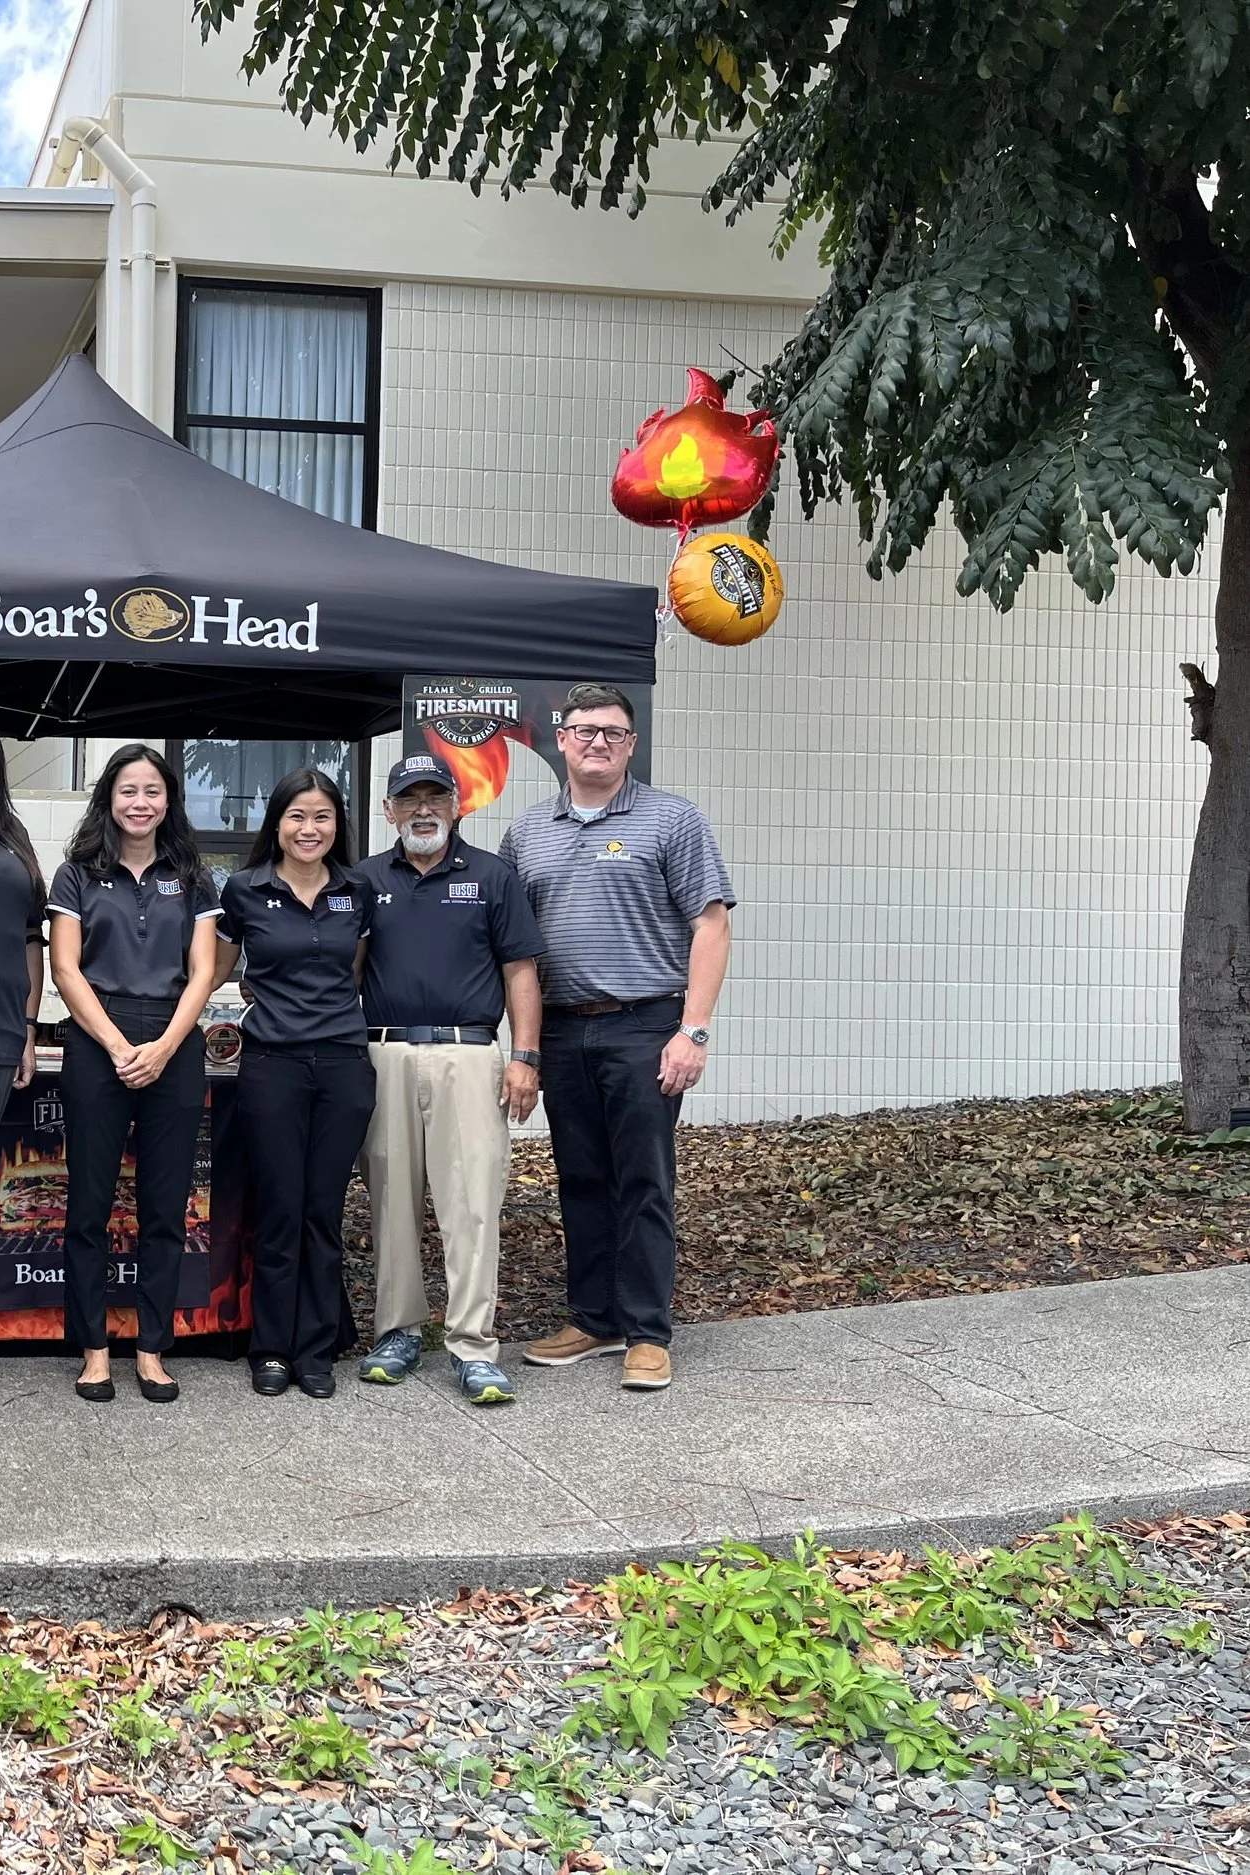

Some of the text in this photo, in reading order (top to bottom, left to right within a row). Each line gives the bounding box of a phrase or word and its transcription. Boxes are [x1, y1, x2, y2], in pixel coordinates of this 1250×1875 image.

[714, 546, 758, 614] FIRESMITH
[189, 595, 320, 653] Head
[423, 686, 513, 694] FLAME GRILLED
[416, 699, 519, 720] FIRESMITH
[435, 720, 497, 744] CHICKEN BREAST
[14, 1263, 66, 1284] Boar
